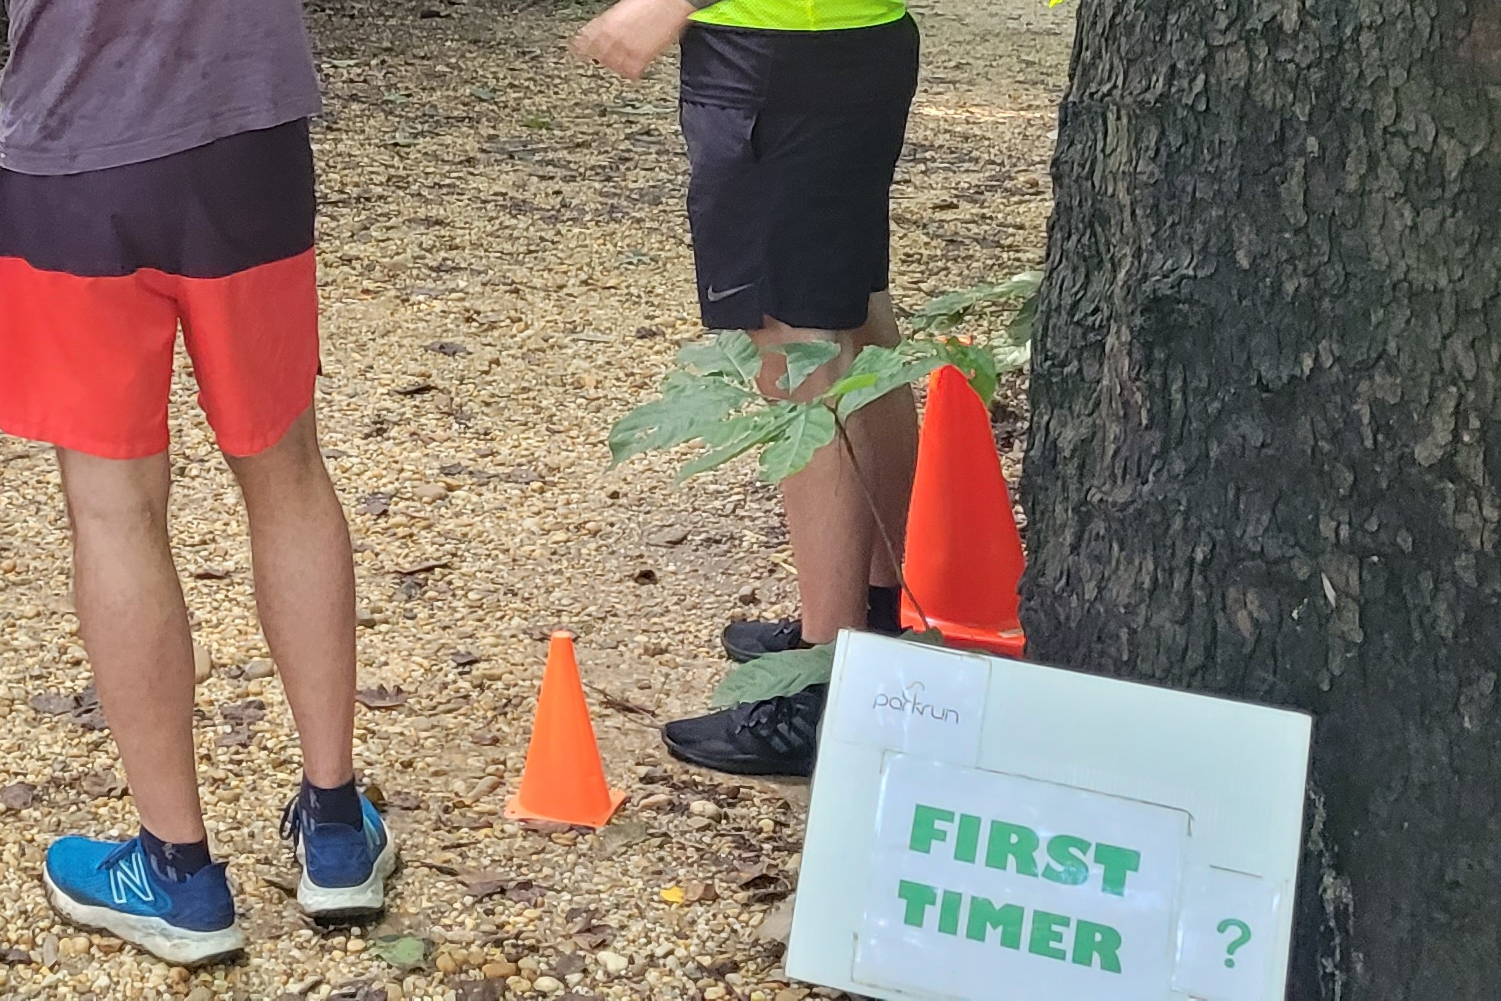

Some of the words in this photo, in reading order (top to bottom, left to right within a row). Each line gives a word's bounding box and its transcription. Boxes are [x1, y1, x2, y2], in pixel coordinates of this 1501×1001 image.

[872, 689, 960, 725] parkrun
[908, 803, 1141, 898] FIRST
[898, 879, 1123, 975] TIMER
